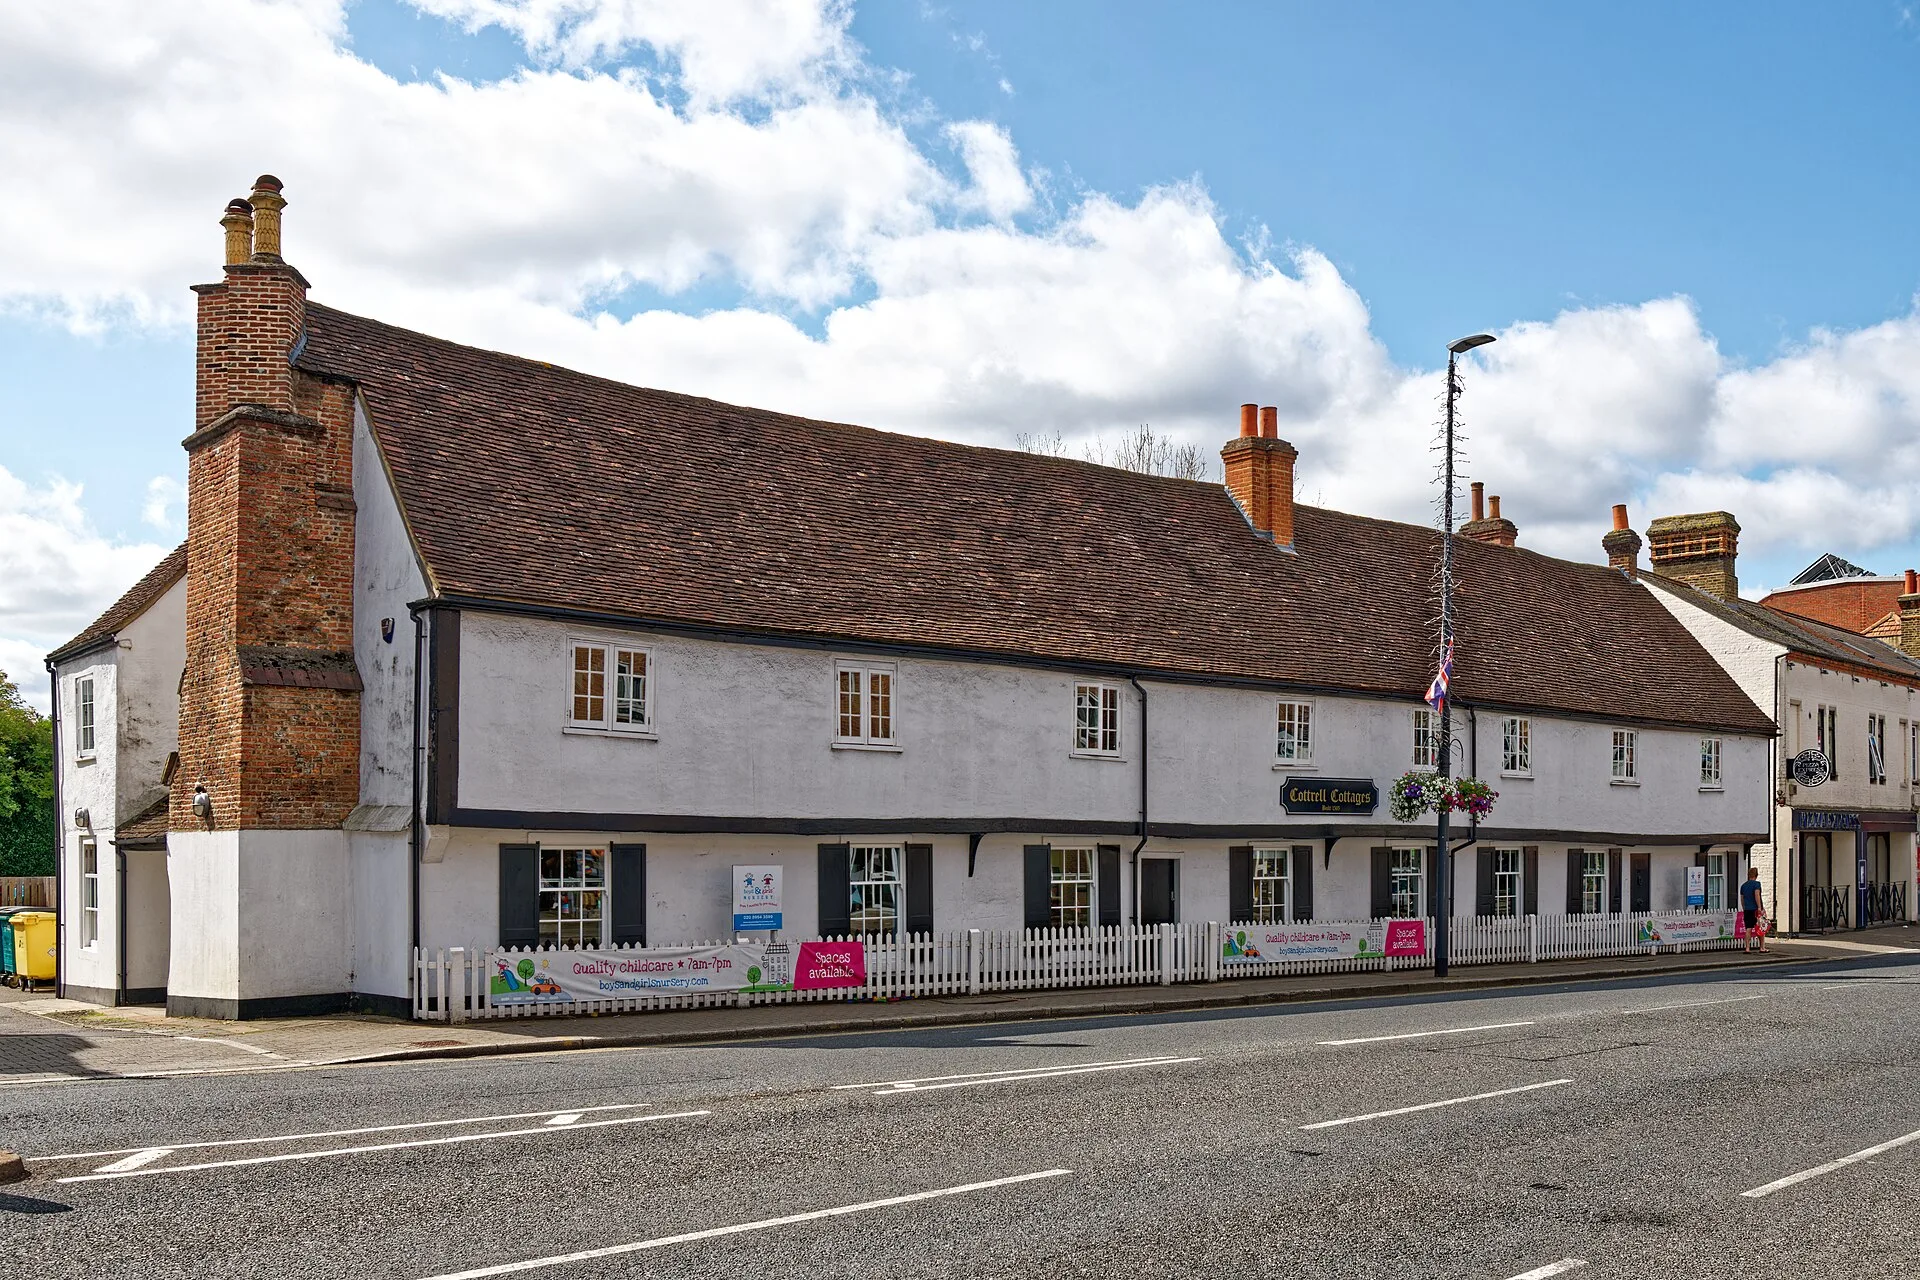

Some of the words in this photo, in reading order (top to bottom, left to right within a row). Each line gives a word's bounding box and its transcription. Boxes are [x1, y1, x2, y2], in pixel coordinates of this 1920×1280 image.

[1290, 787, 1327, 803] Cottrell
[1330, 788, 1371, 806] Cottages
[1265, 931, 1289, 944] Quality
[1290, 931, 1319, 942] childcare
[1326, 931, 1351, 944] 7am-7pm
[1396, 929, 1416, 940] Spaces
[815, 952, 851, 967] Spaces
[573, 960, 616, 977] Quality
[620, 959, 674, 973] childcare
[688, 957, 732, 973] 7am-7pm
[809, 966, 854, 978] available
[600, 977, 709, 991] boysandgirlsnursery.com
